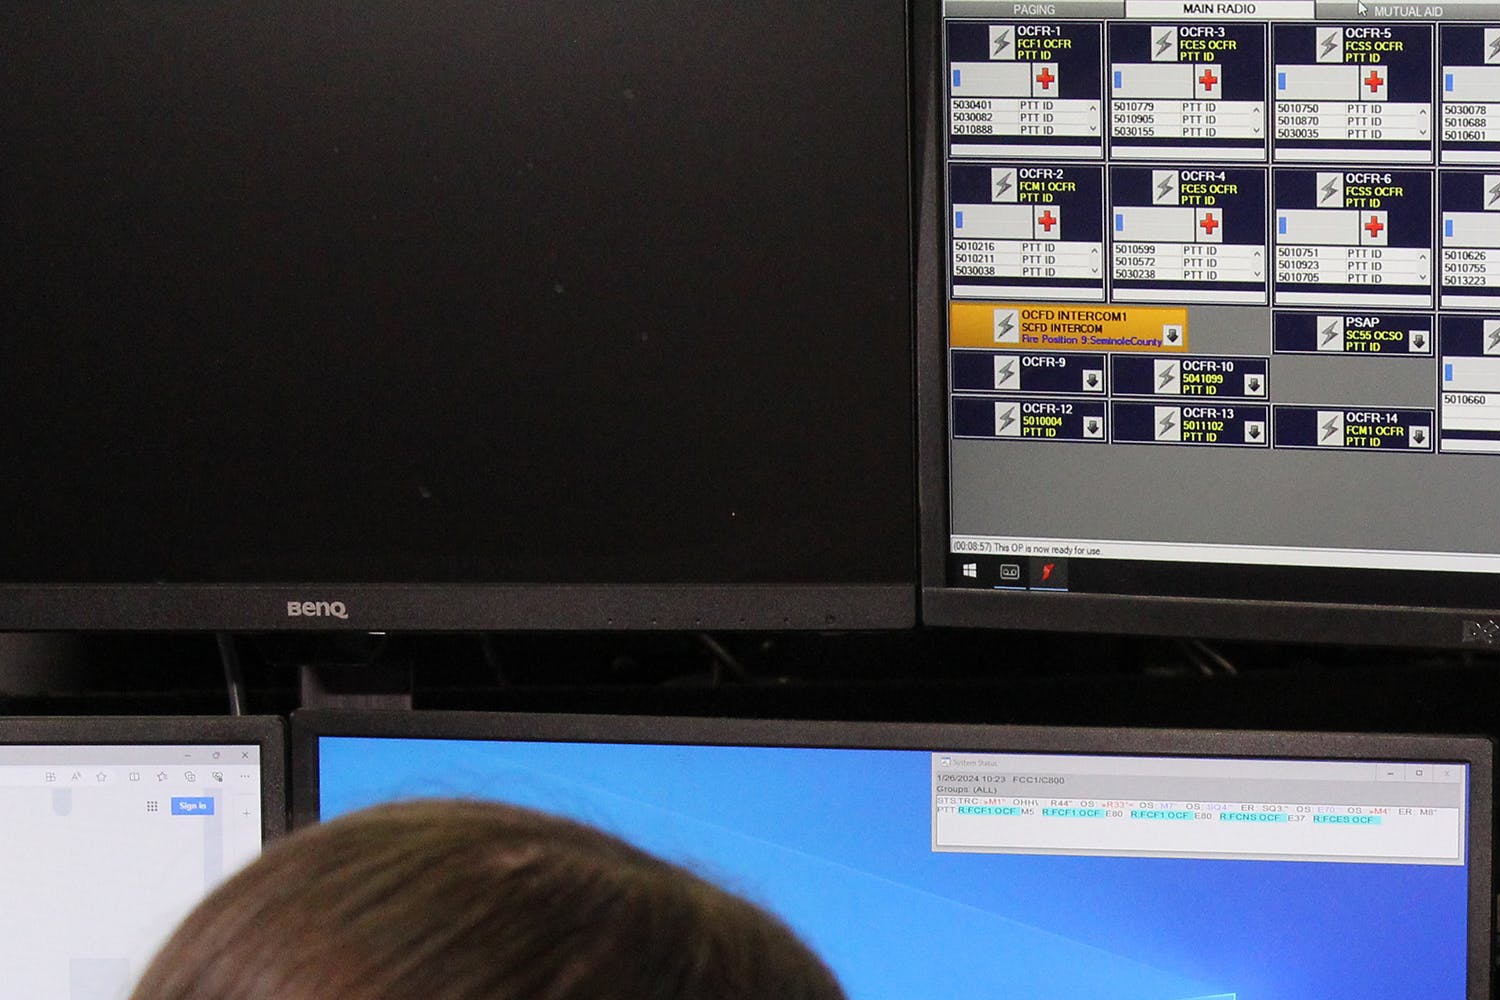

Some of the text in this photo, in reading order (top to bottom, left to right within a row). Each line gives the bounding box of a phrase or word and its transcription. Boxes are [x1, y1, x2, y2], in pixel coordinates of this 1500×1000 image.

[1013, 4, 1055, 15] PAGING
[1183, 3, 1256, 14] MAIN RADIO
[1375, 6, 1442, 17] MUTUAL AID
[1018, 26, 1060, 36] OCFR-1
[1180, 27, 1225, 38] OCFR-3
[1346, 28, 1391, 39] OCFR-5
[1018, 39, 1072, 48] FCF1 OCFR
[1180, 40, 1236, 50] FCES OCFR
[1346, 42, 1403, 51] FCSS OCFR
[953, 101, 992, 110] 5030401
[1114, 102, 1154, 112] 5010779
[1445, 105, 1486, 115] 5030078
[1020, 169, 1063, 179] OCFR-2
[1022, 310, 1127, 321] OCFD INTERCOM1
[1346, 317, 1380, 327] PSAP
[1022, 322, 1102, 333] SCFD INTERCOM
[1023, 403, 1072, 414] OCFR-12
[937, 773, 1006, 785] 1/26/2024 10:23
[179, 801, 196, 811] Sign
